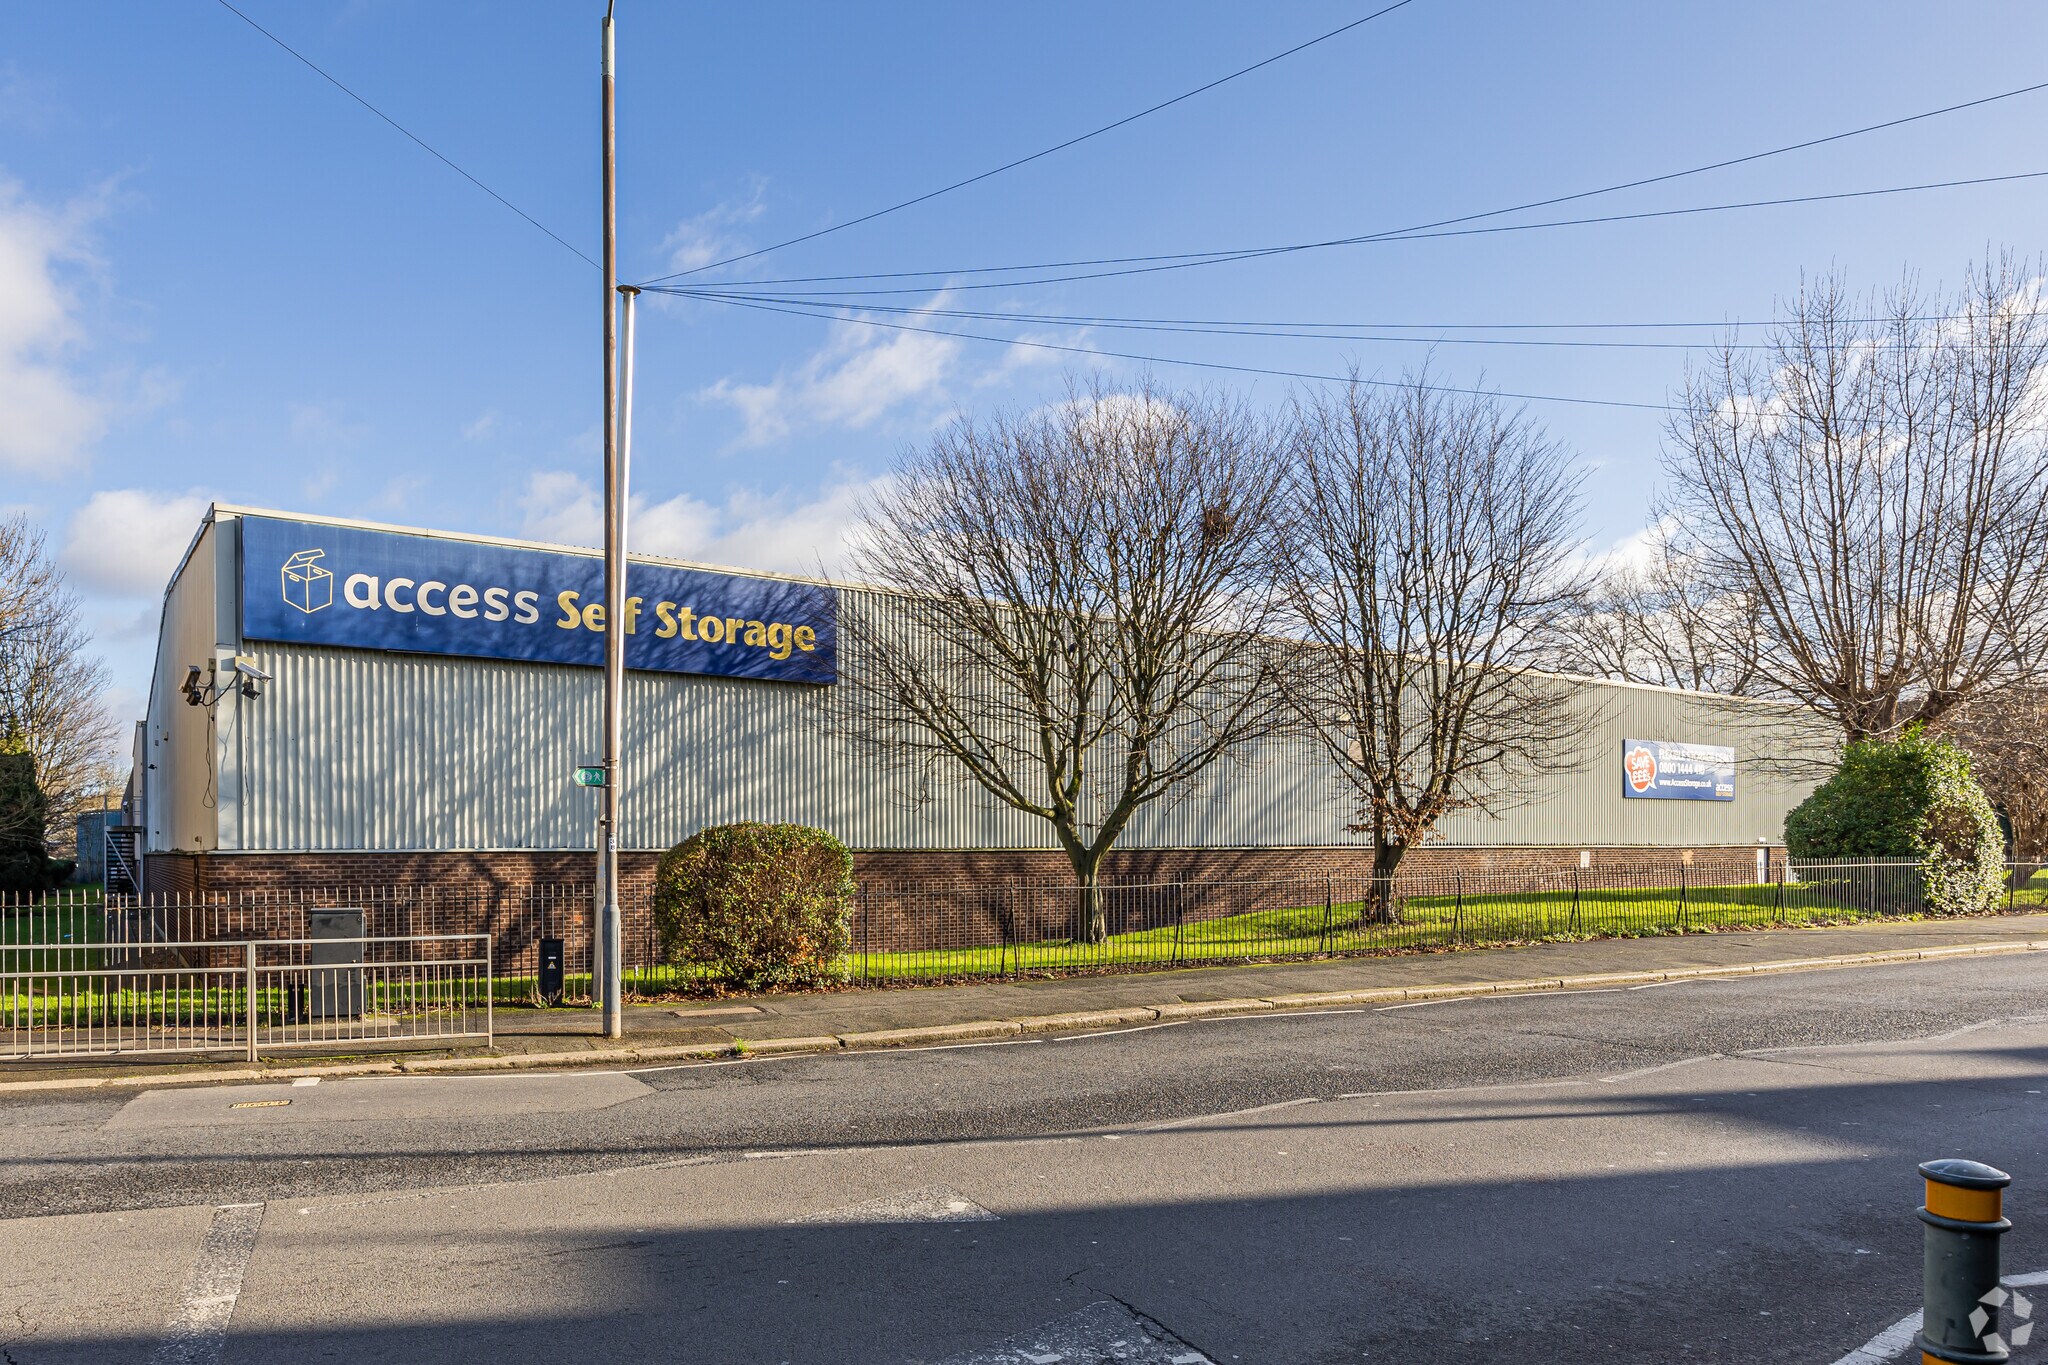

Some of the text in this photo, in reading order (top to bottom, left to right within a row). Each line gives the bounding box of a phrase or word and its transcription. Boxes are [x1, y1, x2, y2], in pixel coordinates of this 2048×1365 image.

[343, 573, 816, 661] access Sef Storage
[1631, 755, 1650, 770] SAVE
[1659, 762, 1676, 774] 0800
[1716, 783, 1734, 792] access
